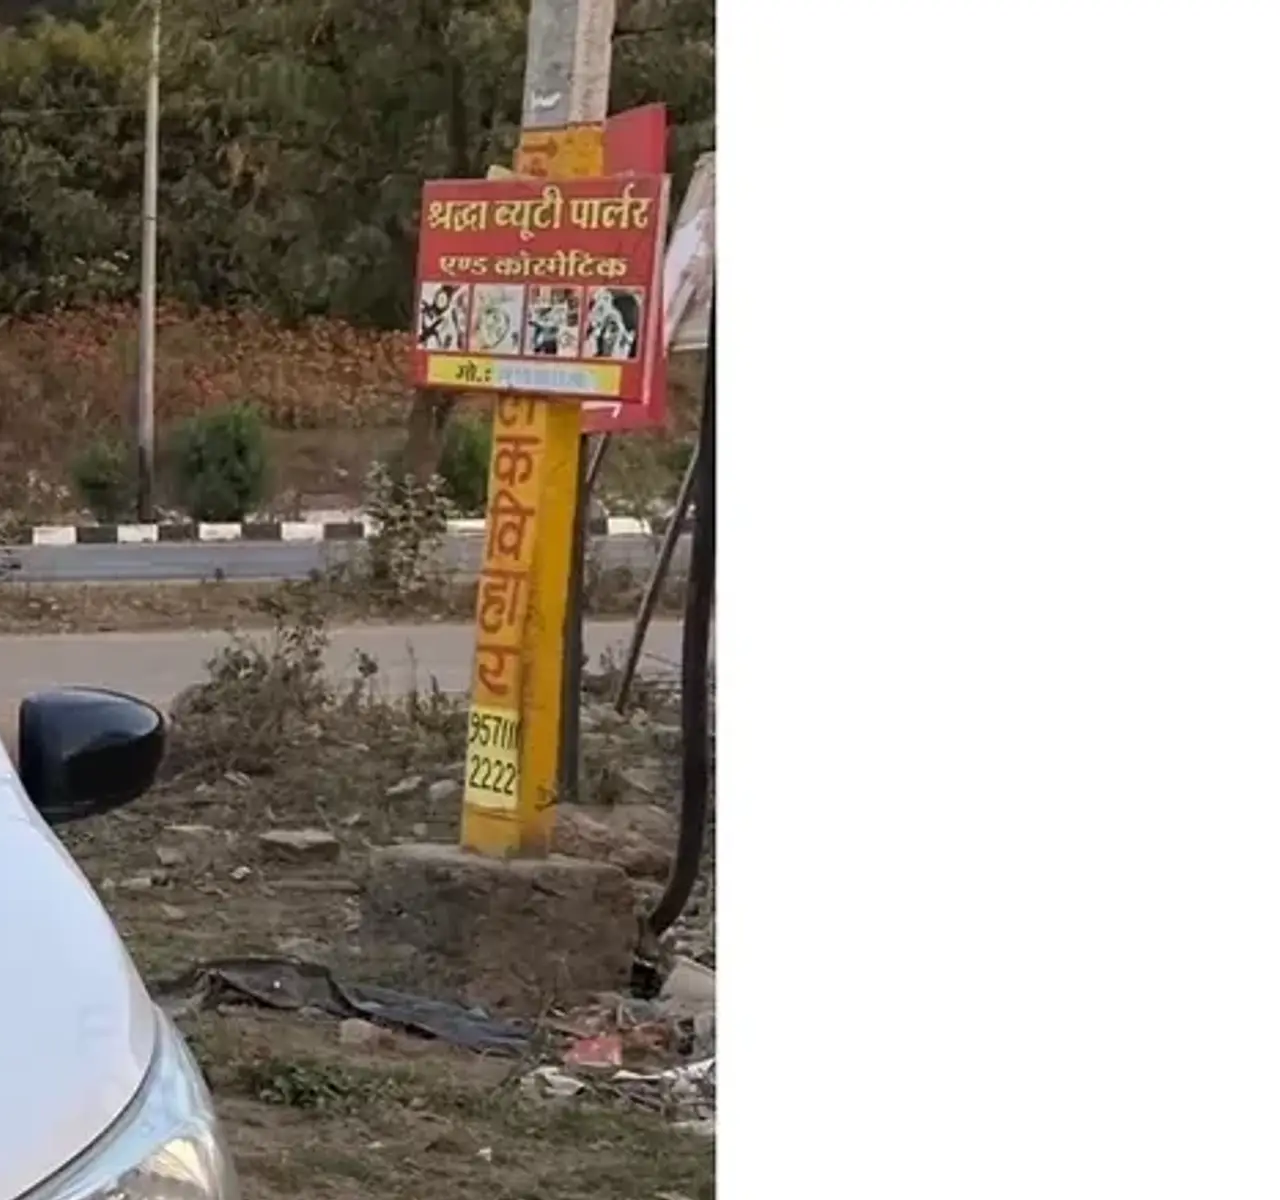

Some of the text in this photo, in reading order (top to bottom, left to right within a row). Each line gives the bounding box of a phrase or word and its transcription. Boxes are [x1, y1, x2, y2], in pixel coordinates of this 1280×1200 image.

[427, 198, 487, 232] श्रद्धा
[570, 182, 654, 231] पार्लर
[469, 753, 517, 797] 2222
